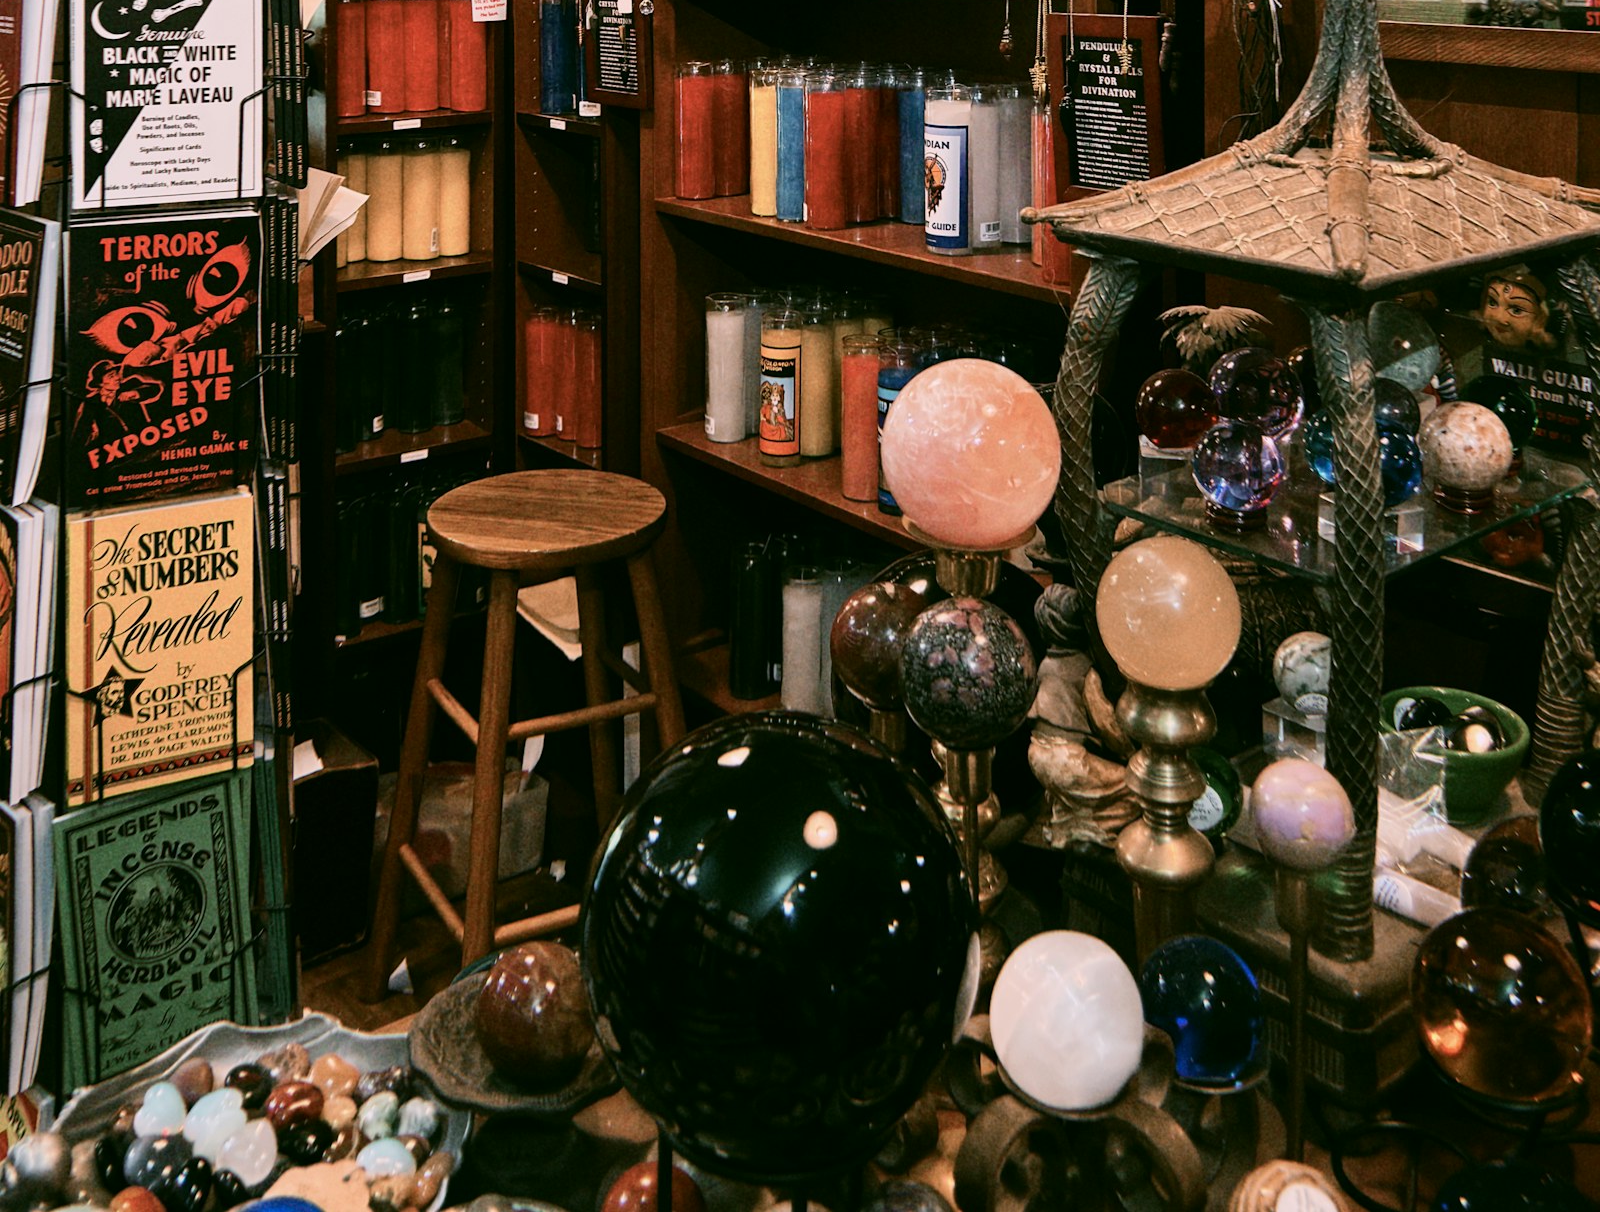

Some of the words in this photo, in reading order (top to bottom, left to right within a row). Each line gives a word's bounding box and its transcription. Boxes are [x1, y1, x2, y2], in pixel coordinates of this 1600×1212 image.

[135, 24, 206, 42] Genuine
[103, 46, 159, 65] BLACK
[184, 45, 236, 61] WHITE
[1103, 53, 1110, 62] &
[129, 67, 182, 85] MAGIC
[190, 67, 211, 82] OF
[1098, 76, 1117, 86] FOR
[106, 89, 161, 108] MARIE
[169, 87, 233, 104] LAVEAU
[1082, 87, 1137, 98] DIVINATION
[140, 145, 176, 154] Significance
[932, 223, 957, 231] GUIDE
[100, 231, 219, 262] TERRORS
[124, 263, 146, 293] of
[149, 262, 180, 280] the
[172, 348, 234, 380] EVIL
[1491, 358, 1537, 381] WALL
[171, 376, 231, 407] EYE
[1530, 385, 1564, 404] from
[212, 430, 227, 442] By
[161, 447, 197, 461] HENRI
[118, 470, 153, 482] Restored
[154, 468, 169, 477] and
[170, 464, 198, 475] Revised
[91, 522, 140, 571] The
[137, 520, 234, 561] SECRET
[96, 569, 121, 599] of
[120, 550, 239, 596] NUMBERS
[84, 589, 243, 673] Revealed
[176, 661, 196, 679] by
[136, 674, 232, 705] GODFREY
[137, 690, 233, 724] SPENCER
[111, 722, 174, 742] CATHERINE
[111, 738, 150, 754] LEWIS
[154, 736, 165, 744] de
[111, 755, 130, 765] DR.
[133, 749, 155, 760] ROY
[158, 742, 188, 753] PAGE
[191, 732, 231, 748] WALTO
[76, 794, 220, 853] LEGENDS
[142, 830, 158, 843] OF
[94, 840, 211, 901] INCENSE
[100, 962, 231, 1028] MAGIC
